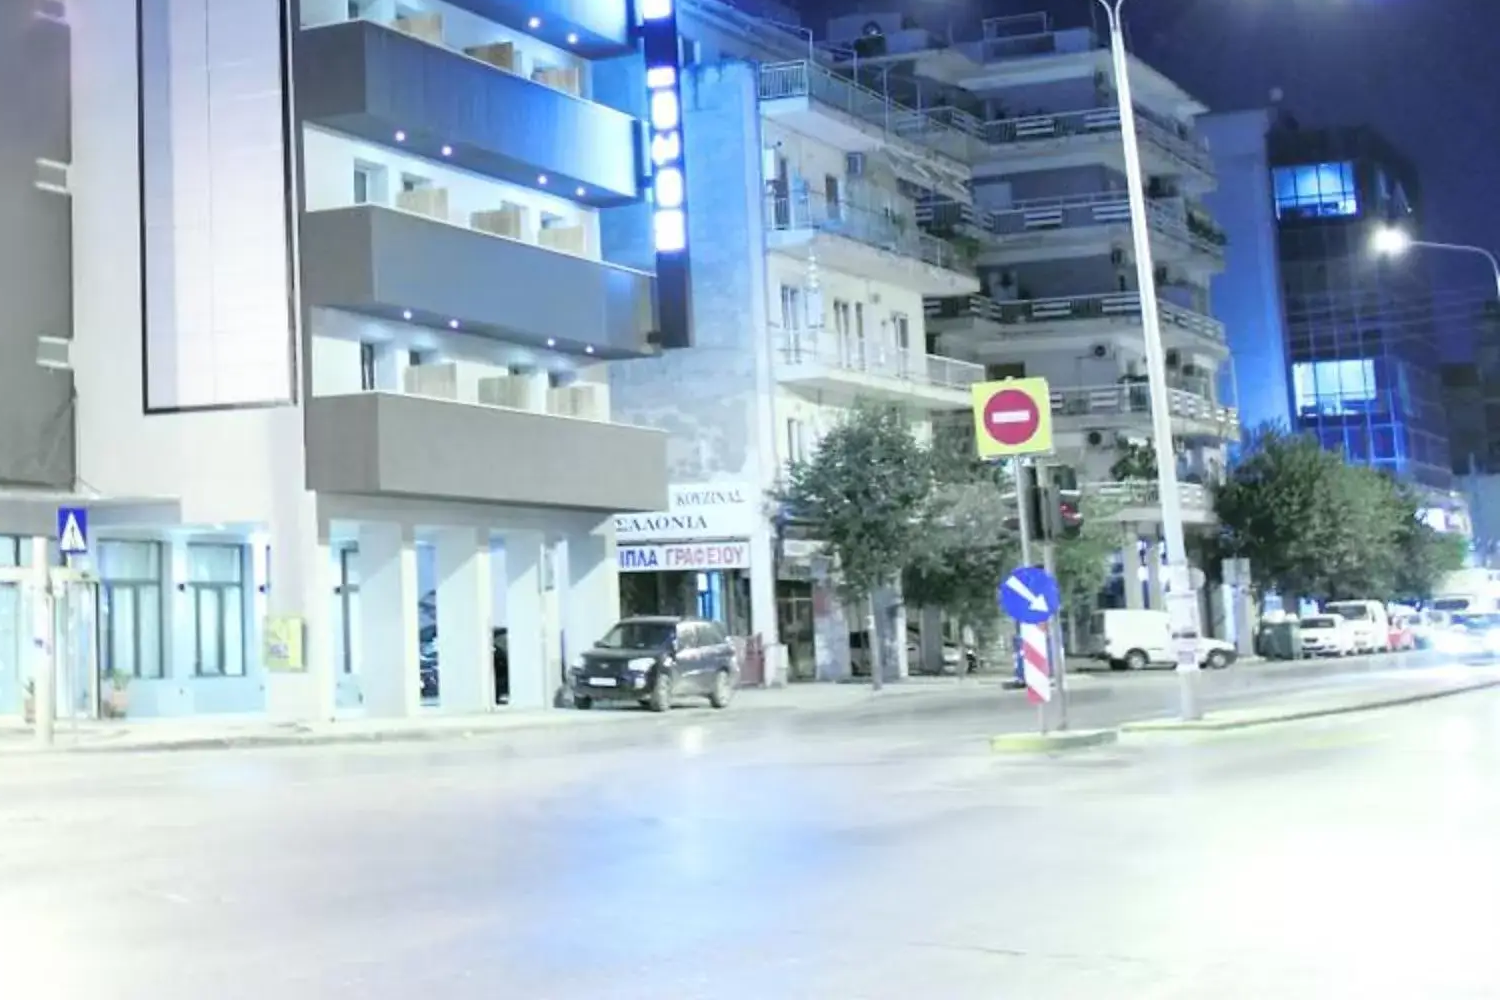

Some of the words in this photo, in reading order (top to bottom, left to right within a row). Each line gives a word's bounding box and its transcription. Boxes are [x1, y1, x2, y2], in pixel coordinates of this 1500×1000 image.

[676, 488, 746, 506] ΚΟΥΖΙΝΑΣ
[615, 515, 708, 532] ΣΑΛΟΝΙΑ
[665, 546, 744, 566] ΓΡΑΦΕΙΟΥ
